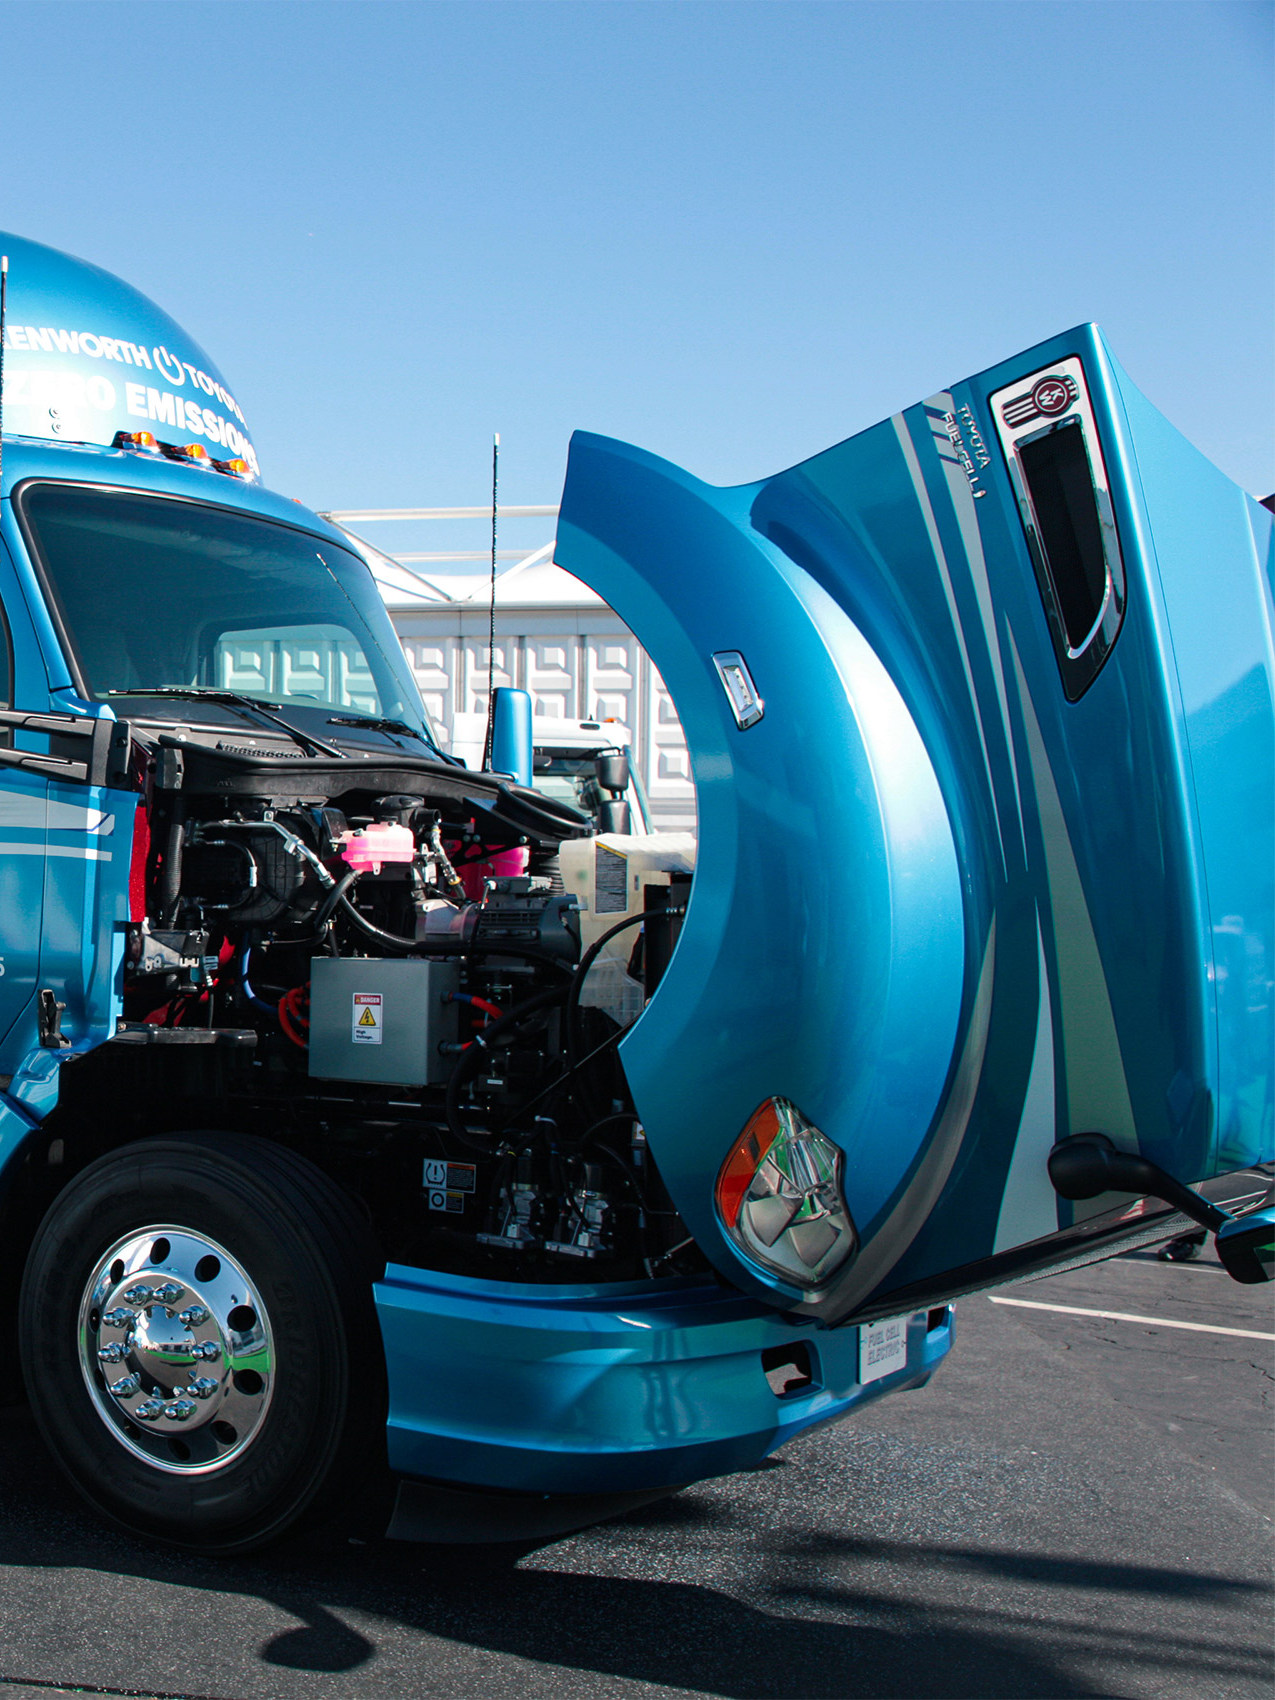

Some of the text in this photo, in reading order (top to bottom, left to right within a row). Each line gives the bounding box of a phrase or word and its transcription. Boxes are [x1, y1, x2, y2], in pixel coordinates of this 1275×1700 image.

[125, 381, 260, 477] EMISSIONS
[940, 411, 964, 452] FUEL
[956, 402, 992, 470] TOYOTA
[867, 1339, 900, 1366] ELECTRIC
[868, 1322, 900, 1349] FUEL CELL
